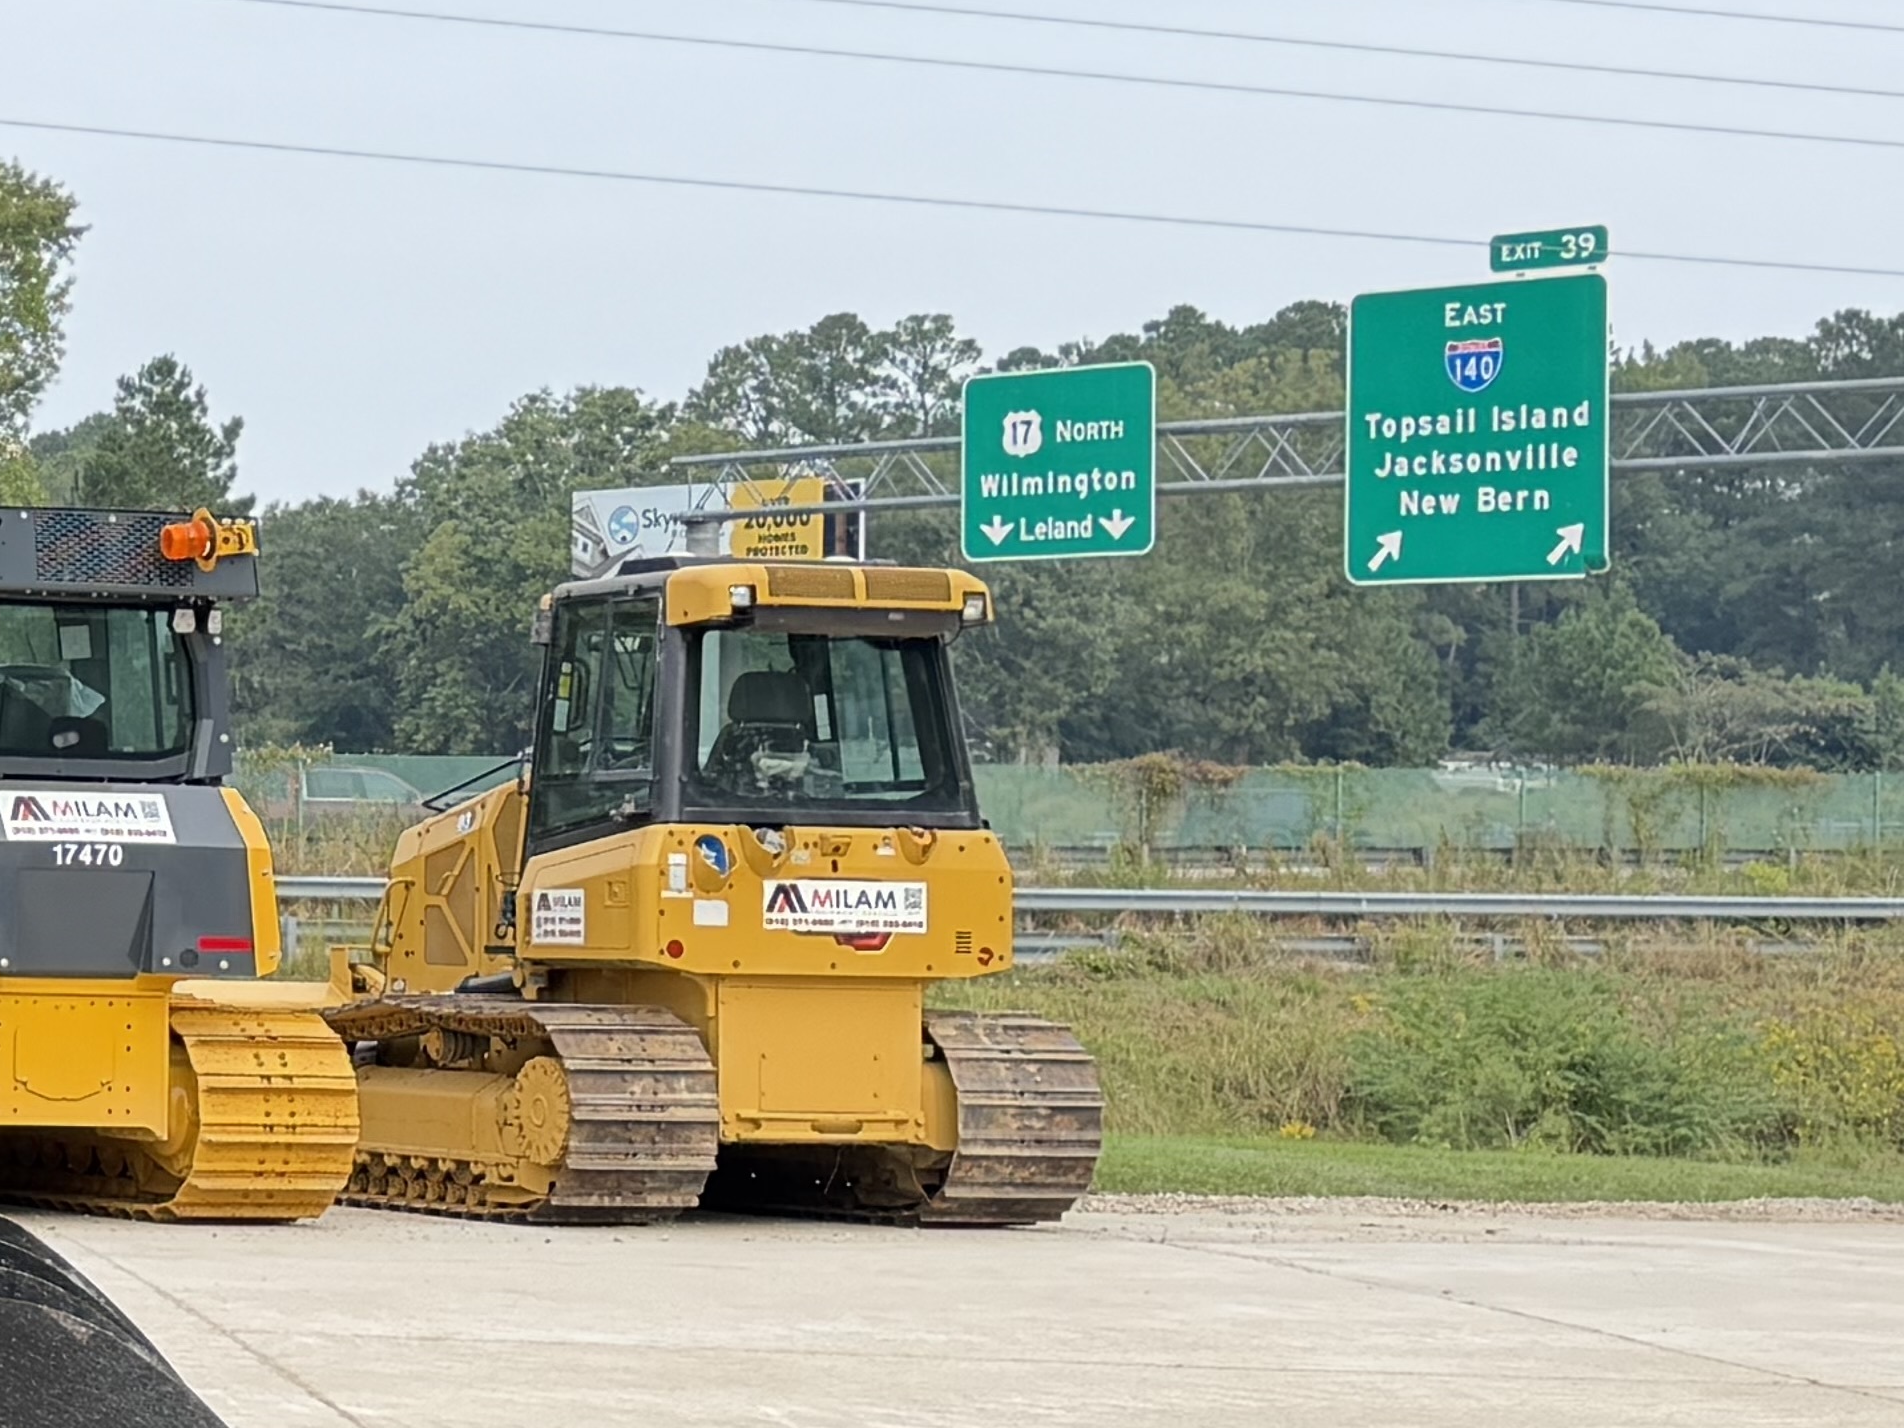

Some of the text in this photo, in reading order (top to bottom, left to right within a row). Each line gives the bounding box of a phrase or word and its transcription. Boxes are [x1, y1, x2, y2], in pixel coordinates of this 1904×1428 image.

[1500, 232, 1596, 262] EXIT 39
[1444, 302, 1506, 328] EAST
[1455, 355, 1494, 381] 140
[1011, 419, 1124, 446] 17 NORTH
[1364, 400, 1590, 443] Topsail Island
[1374, 443, 1578, 478] Jacksonville
[980, 467, 1136, 500] Wilmington
[1399, 486, 1550, 516] New Bern
[1019, 513, 1093, 541] Leland
[52, 800, 138, 819] MILAM
[52, 844, 123, 866] 17470
[811, 889, 897, 909] MILAM
